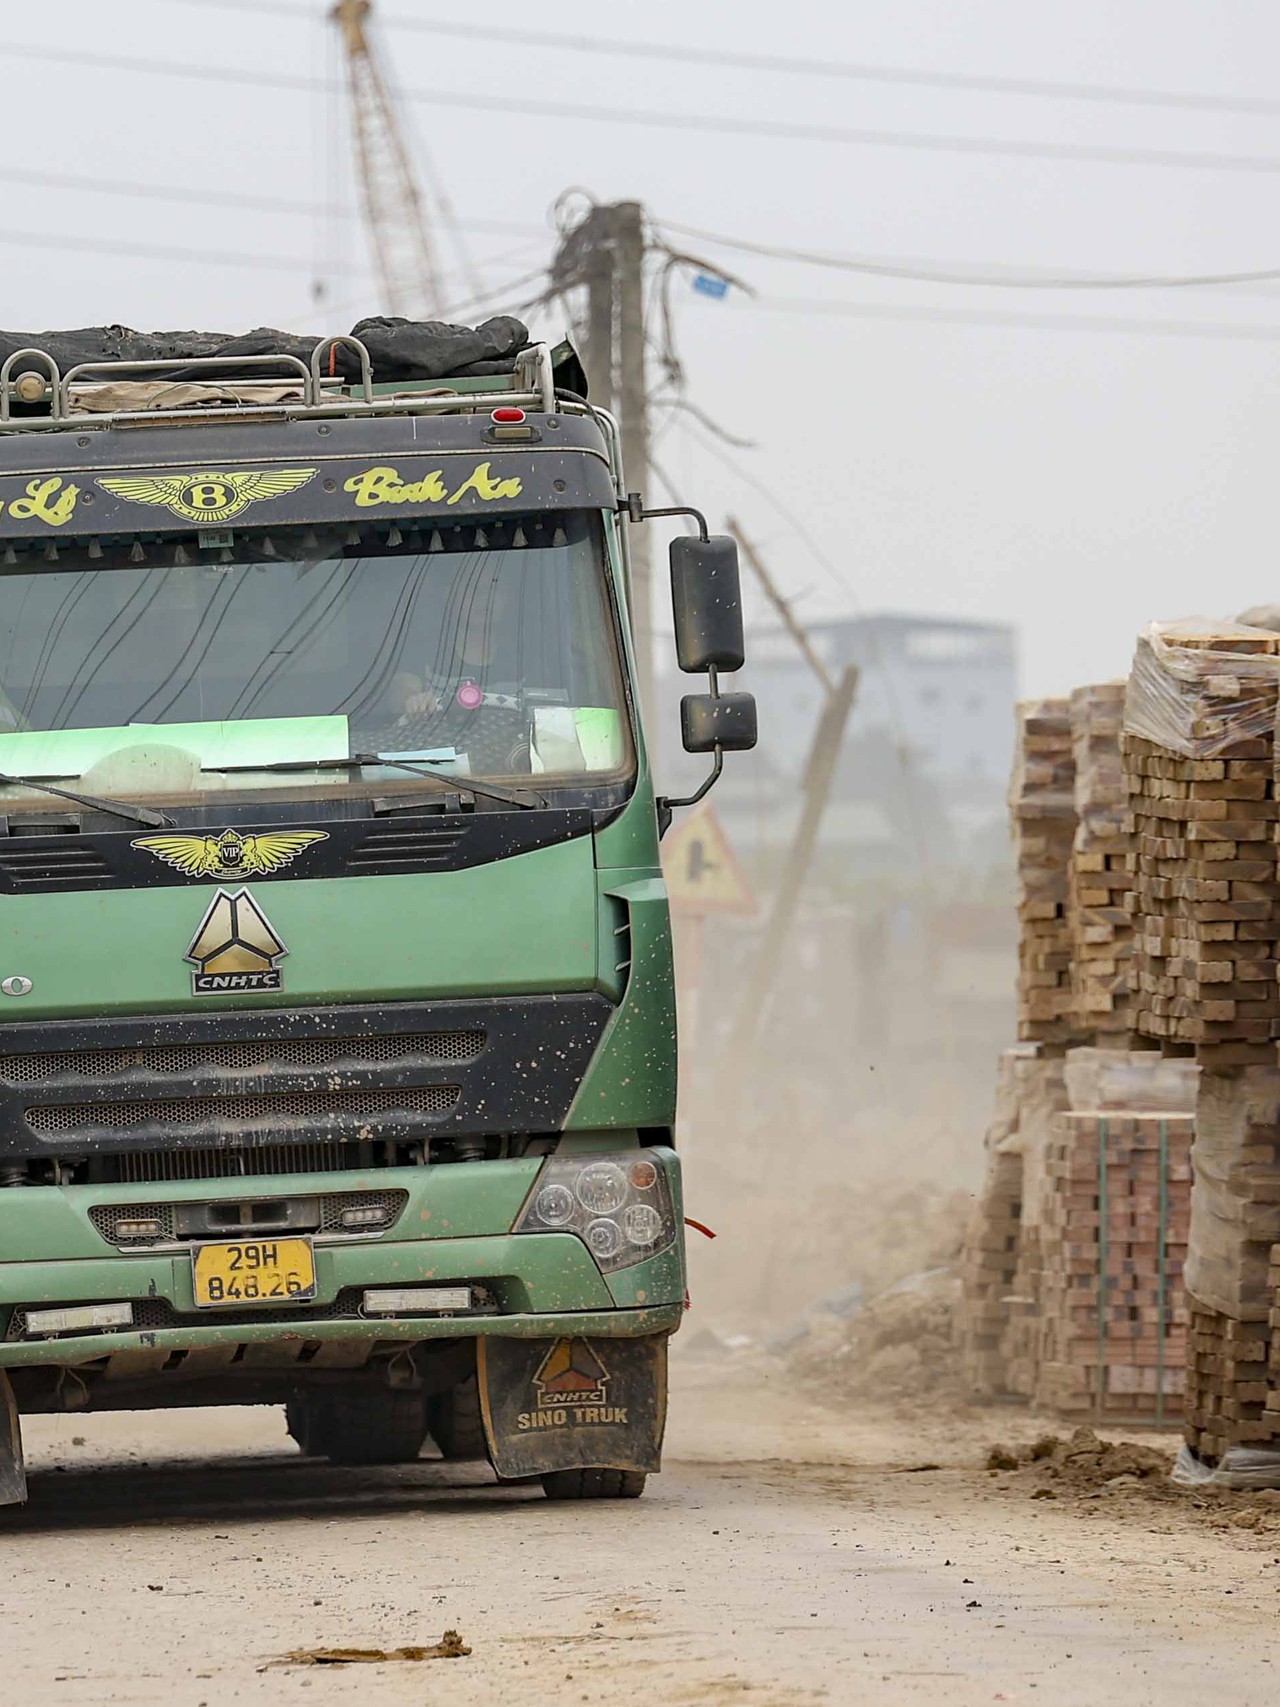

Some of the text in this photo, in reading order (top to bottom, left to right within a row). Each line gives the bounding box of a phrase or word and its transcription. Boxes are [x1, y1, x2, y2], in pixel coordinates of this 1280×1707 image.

[223, 847, 239, 858] VIP
[198, 973, 278, 989] CNHTC
[226, 1243, 279, 1271] 29H
[544, 1391, 602, 1403] CNHTC
[517, 1406, 629, 1430] SINO TRUK
